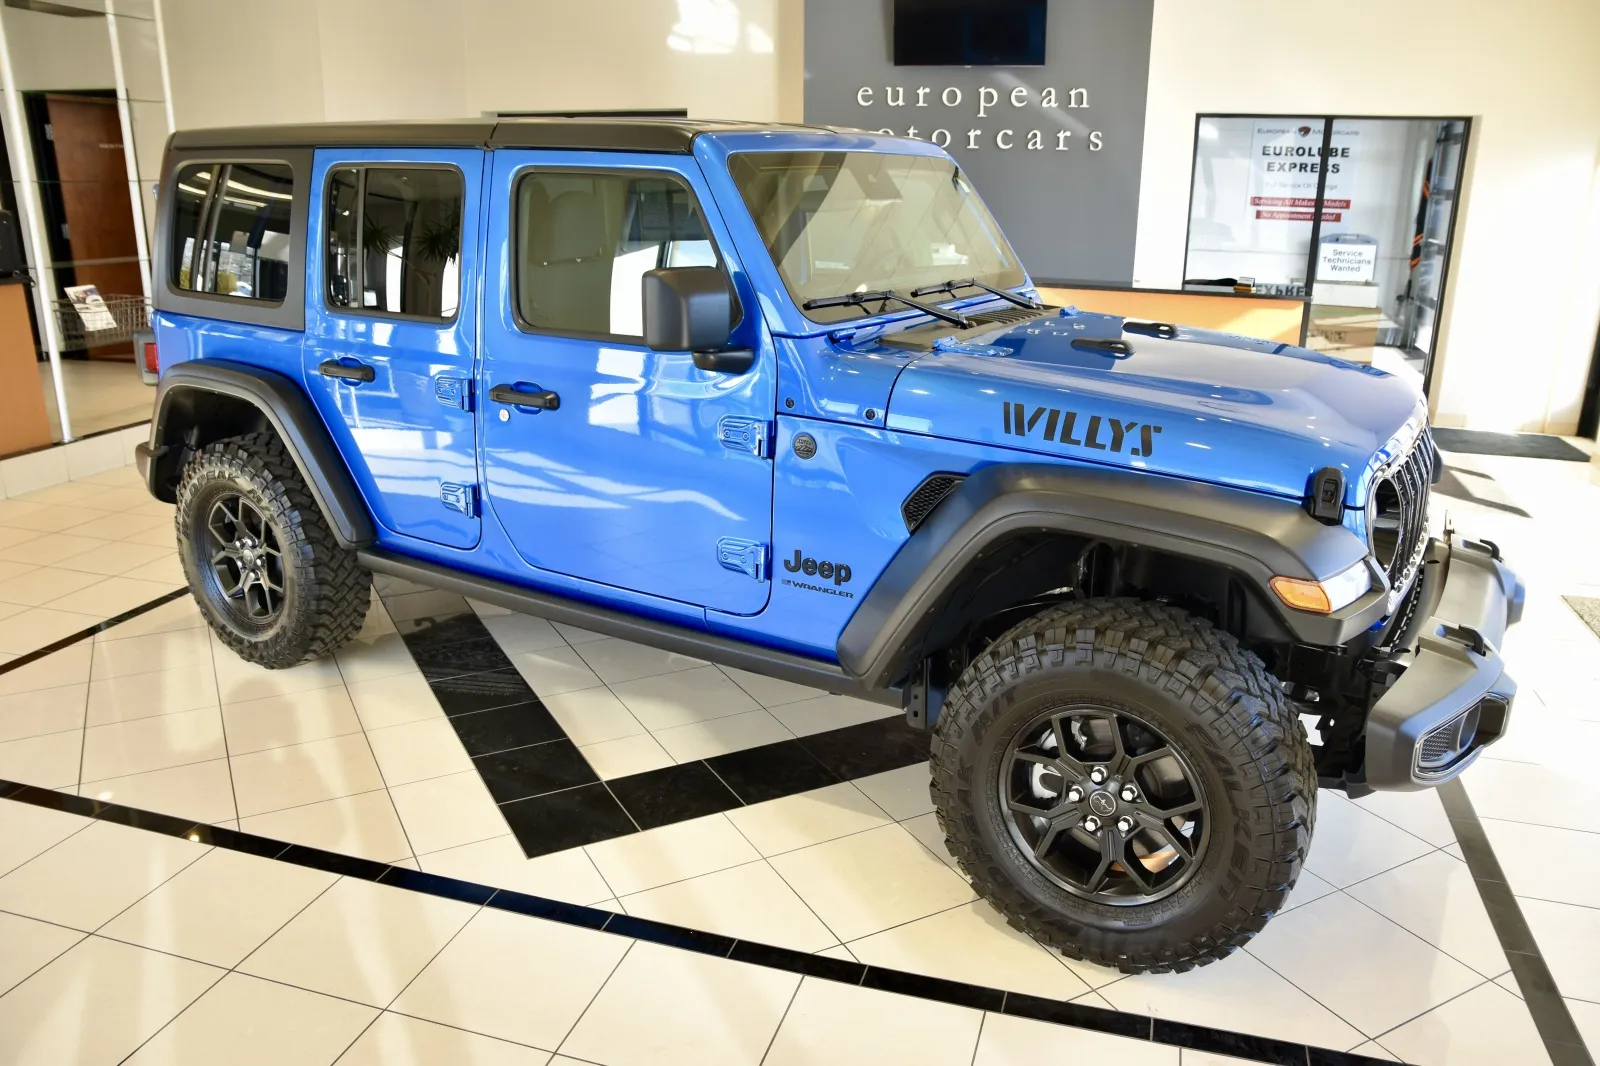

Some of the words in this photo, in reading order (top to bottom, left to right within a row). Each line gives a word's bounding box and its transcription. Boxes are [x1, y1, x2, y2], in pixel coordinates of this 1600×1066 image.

[857, 85, 1090, 118] european
[1266, 161, 1341, 174] EXPRES
[1322, 256, 1372, 266] Technicians
[1332, 249, 1363, 257] Service
[1330, 264, 1361, 273] Wanted
[1003, 401, 1163, 458] WILLYS
[783, 549, 852, 586] Jeep
[792, 580, 854, 600] WRANGLER
